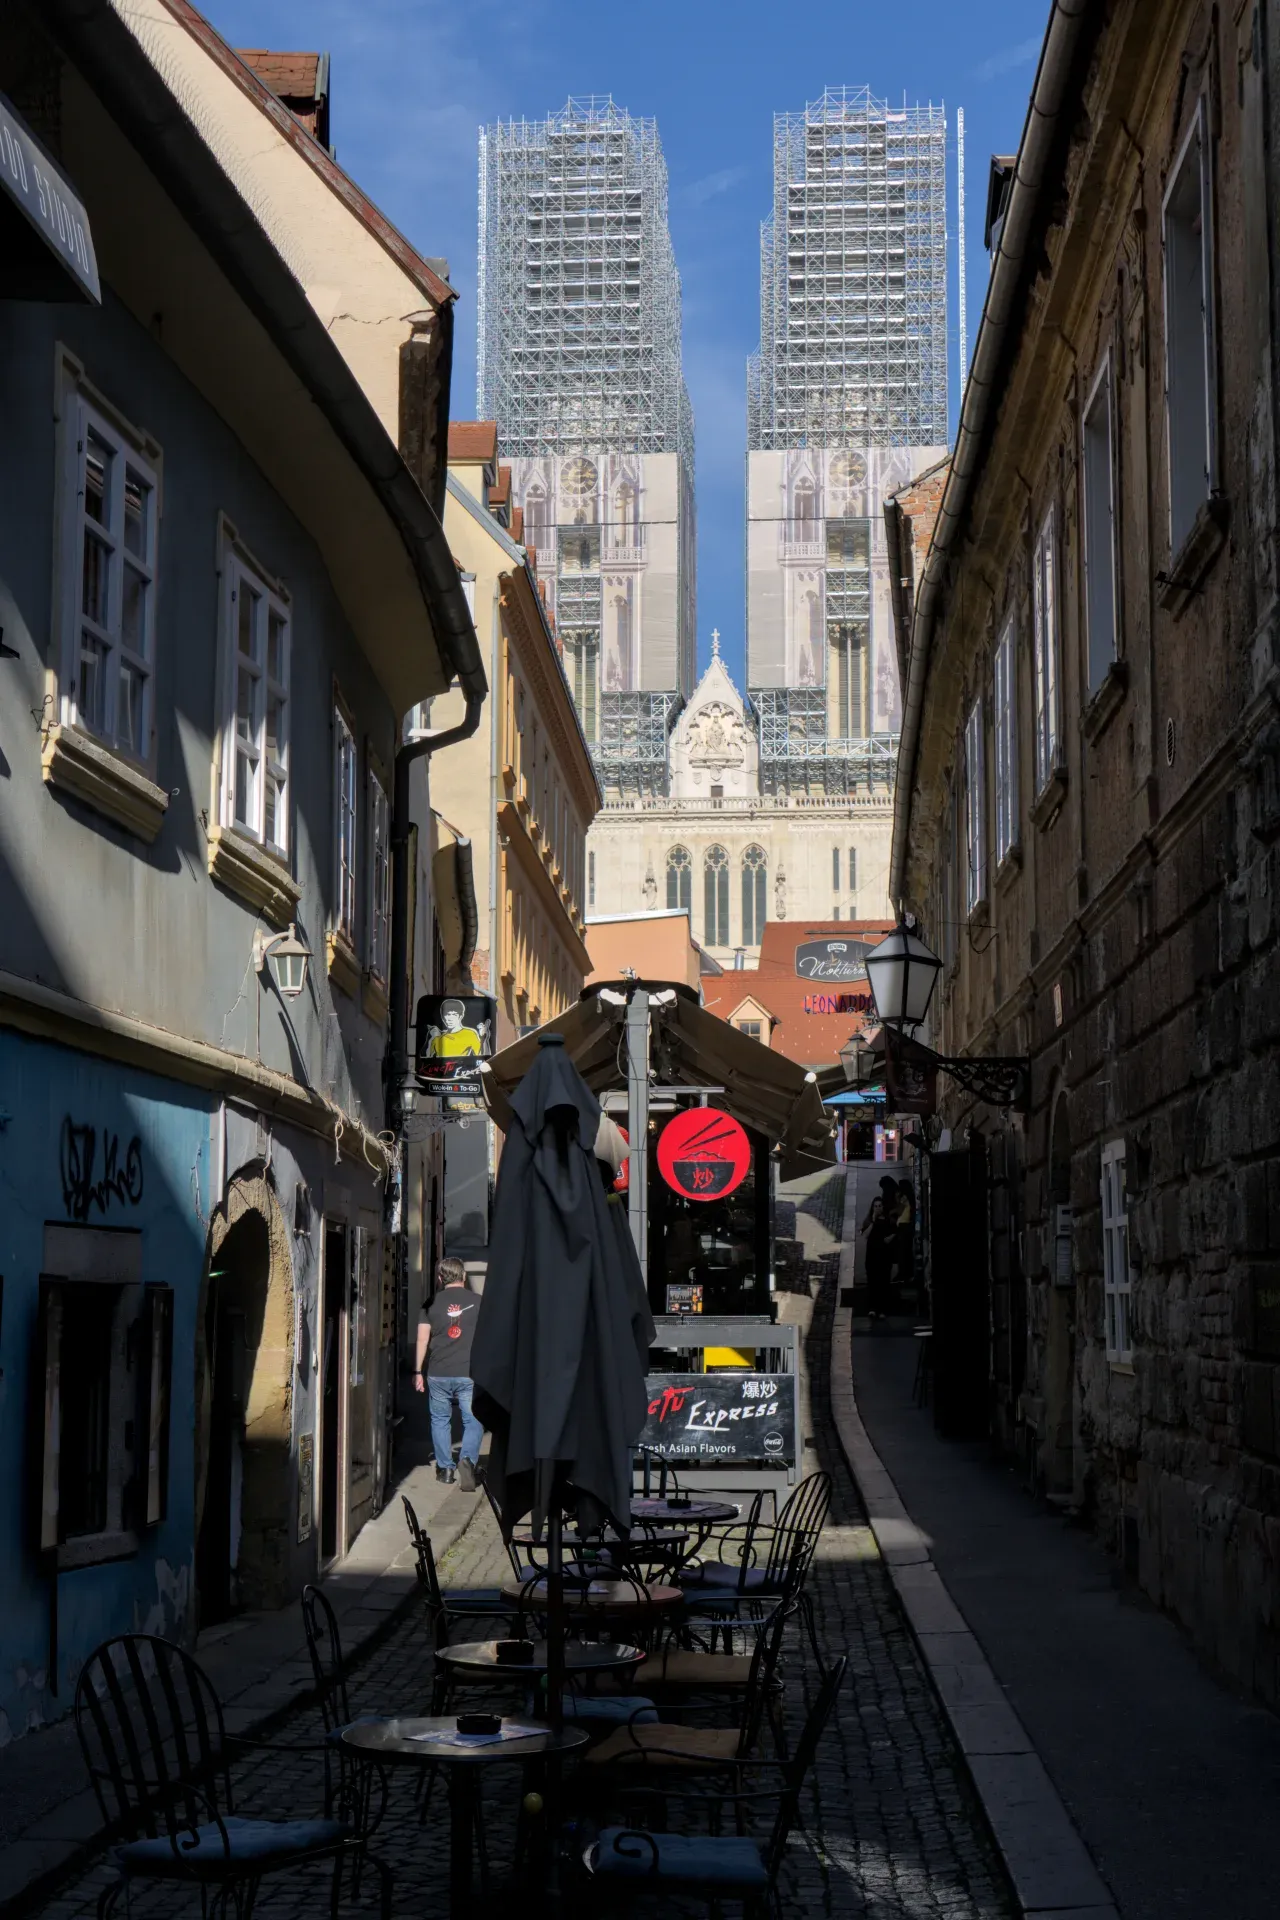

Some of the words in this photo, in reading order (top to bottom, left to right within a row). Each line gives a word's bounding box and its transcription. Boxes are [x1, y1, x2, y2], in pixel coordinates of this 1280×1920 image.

[33, 163, 90, 275] STUDIO
[460, 1084, 478, 1092] To-Go
[669, 1443, 697, 1453] Asian
[700, 1443, 736, 1453] Flavors
